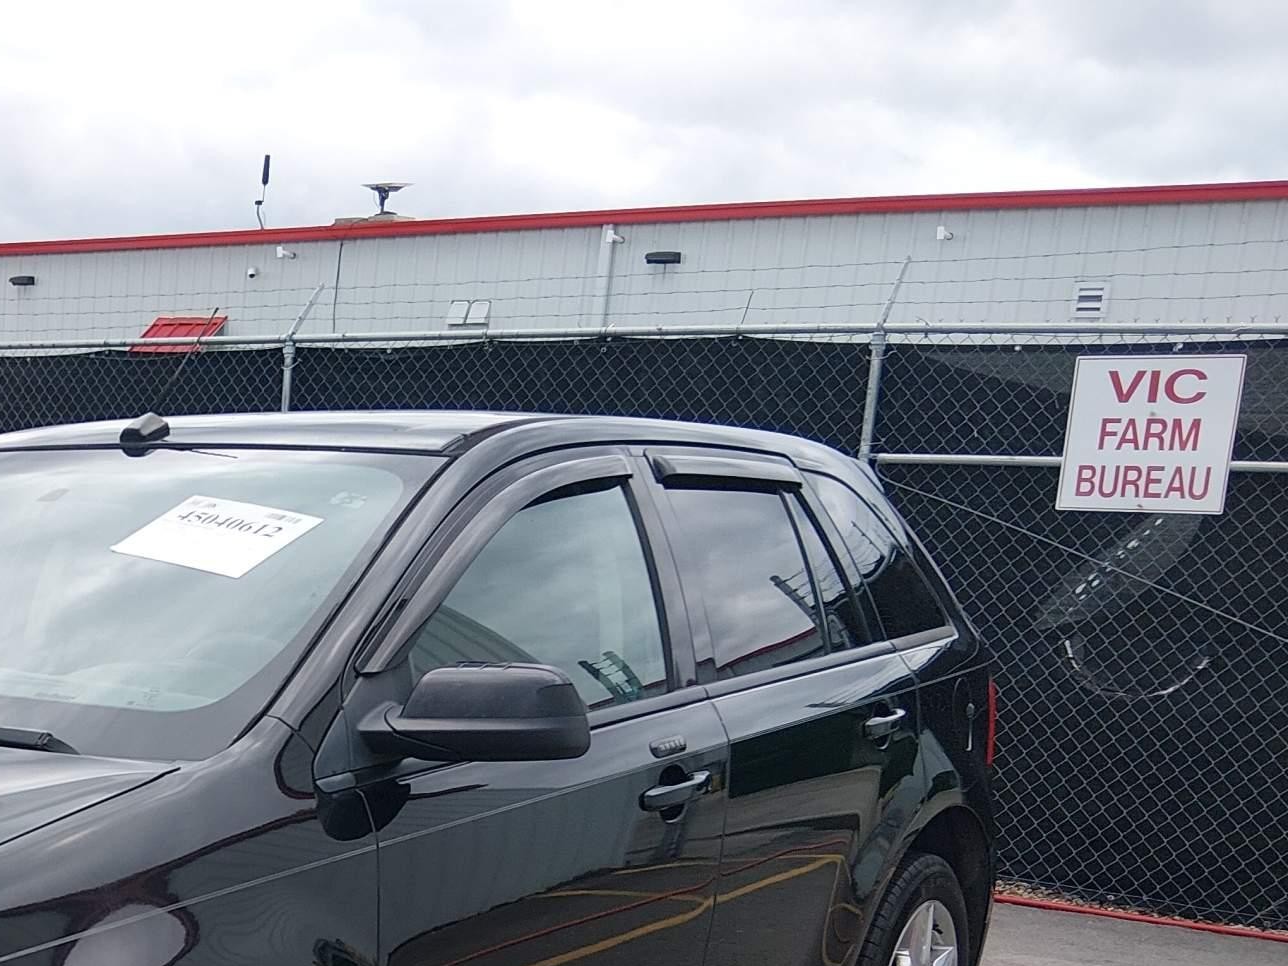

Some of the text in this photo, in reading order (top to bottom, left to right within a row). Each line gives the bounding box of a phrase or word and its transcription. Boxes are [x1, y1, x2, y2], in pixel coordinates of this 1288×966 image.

[1109, 369, 1208, 404] VIC
[1098, 418, 1201, 451] FARM
[1075, 465, 1211, 500] BUREAU
[177, 510, 283, 538] 45040612
